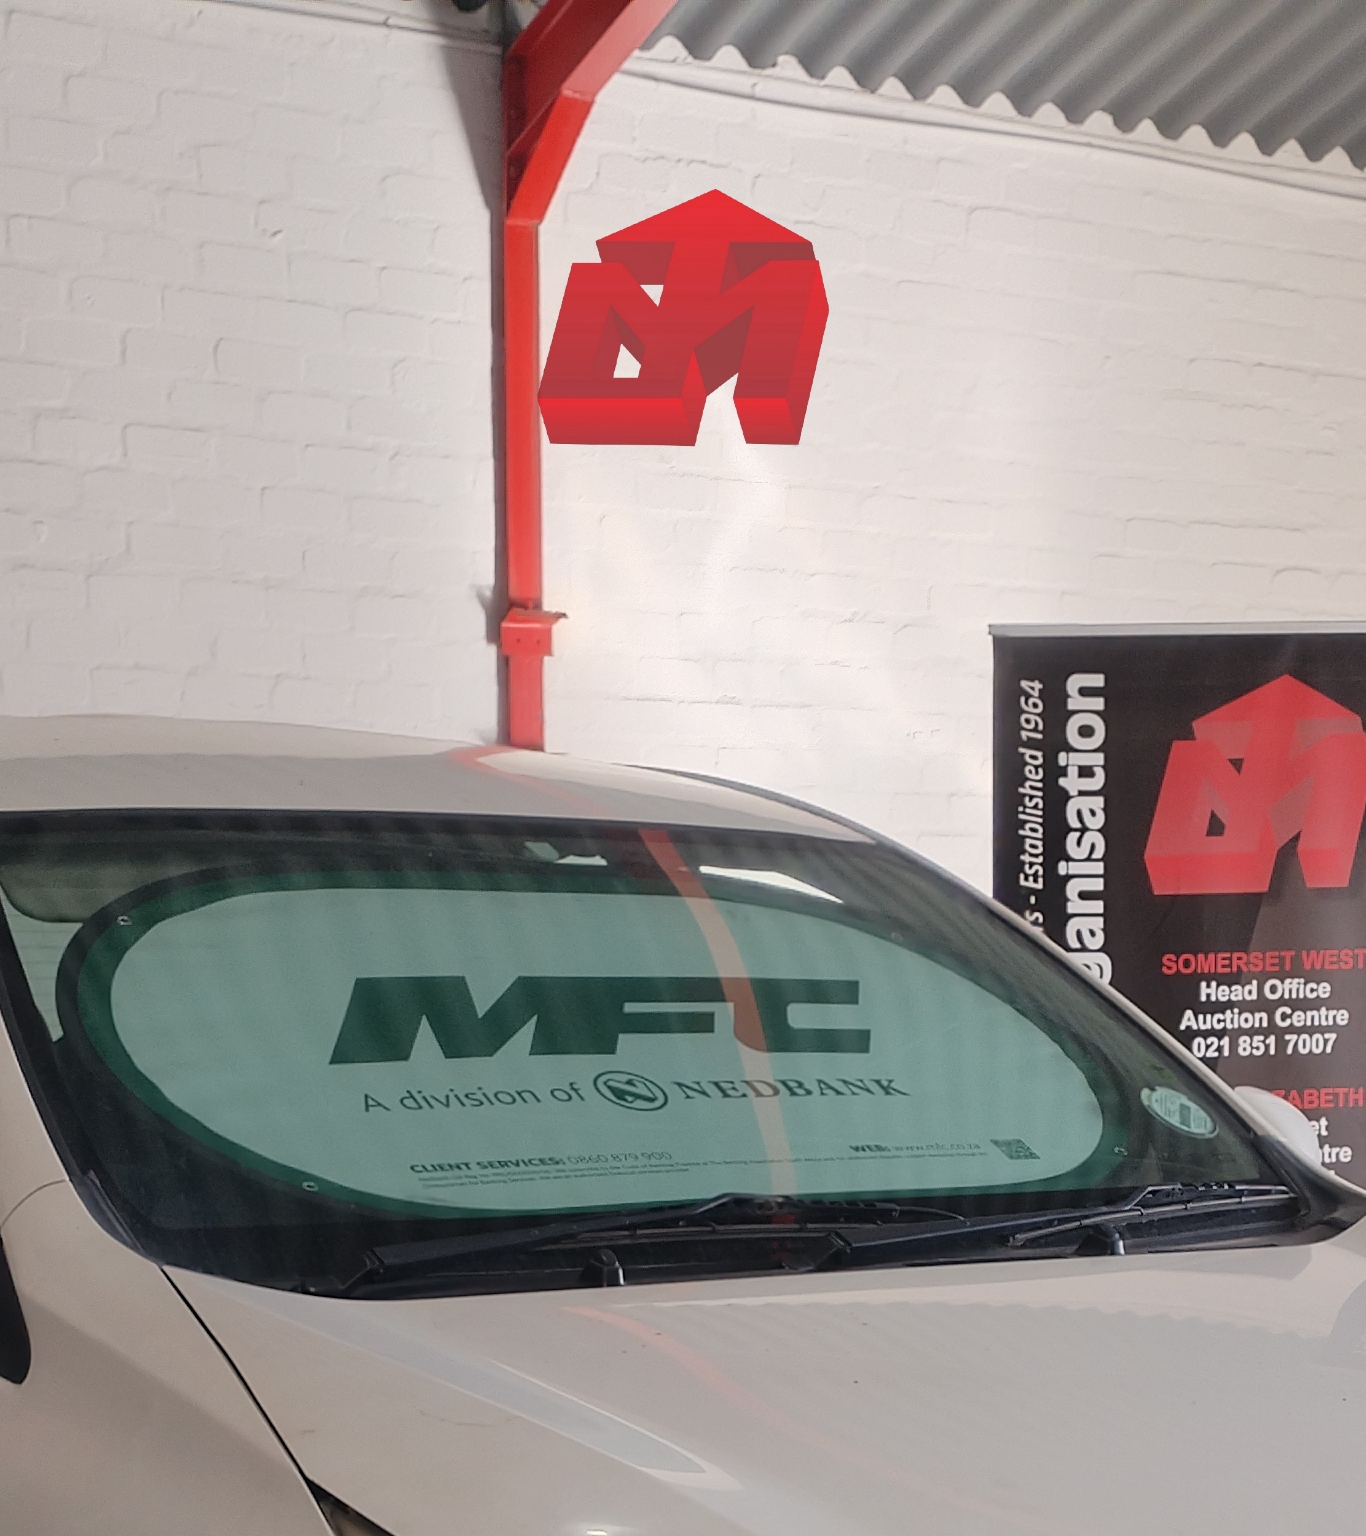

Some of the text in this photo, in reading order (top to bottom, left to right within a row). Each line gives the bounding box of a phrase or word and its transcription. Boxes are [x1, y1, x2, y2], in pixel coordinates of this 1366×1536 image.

[1019, 679, 1044, 738] 1964
[1017, 742, 1044, 890] Established
[1161, 950, 1296, 976] SOMERSET
[1200, 977, 1332, 1002] Head Office
[328, 975, 872, 1066] MFC
[1179, 1006, 1350, 1031] Auction Centre
[1192, 1032, 1338, 1058] 021 851 7007
[363, 1078, 910, 1113] A division of NEDBANK
[409, 1162, 473, 1175] CLIENT
[475, 1156, 566, 1171] SERVICES:
